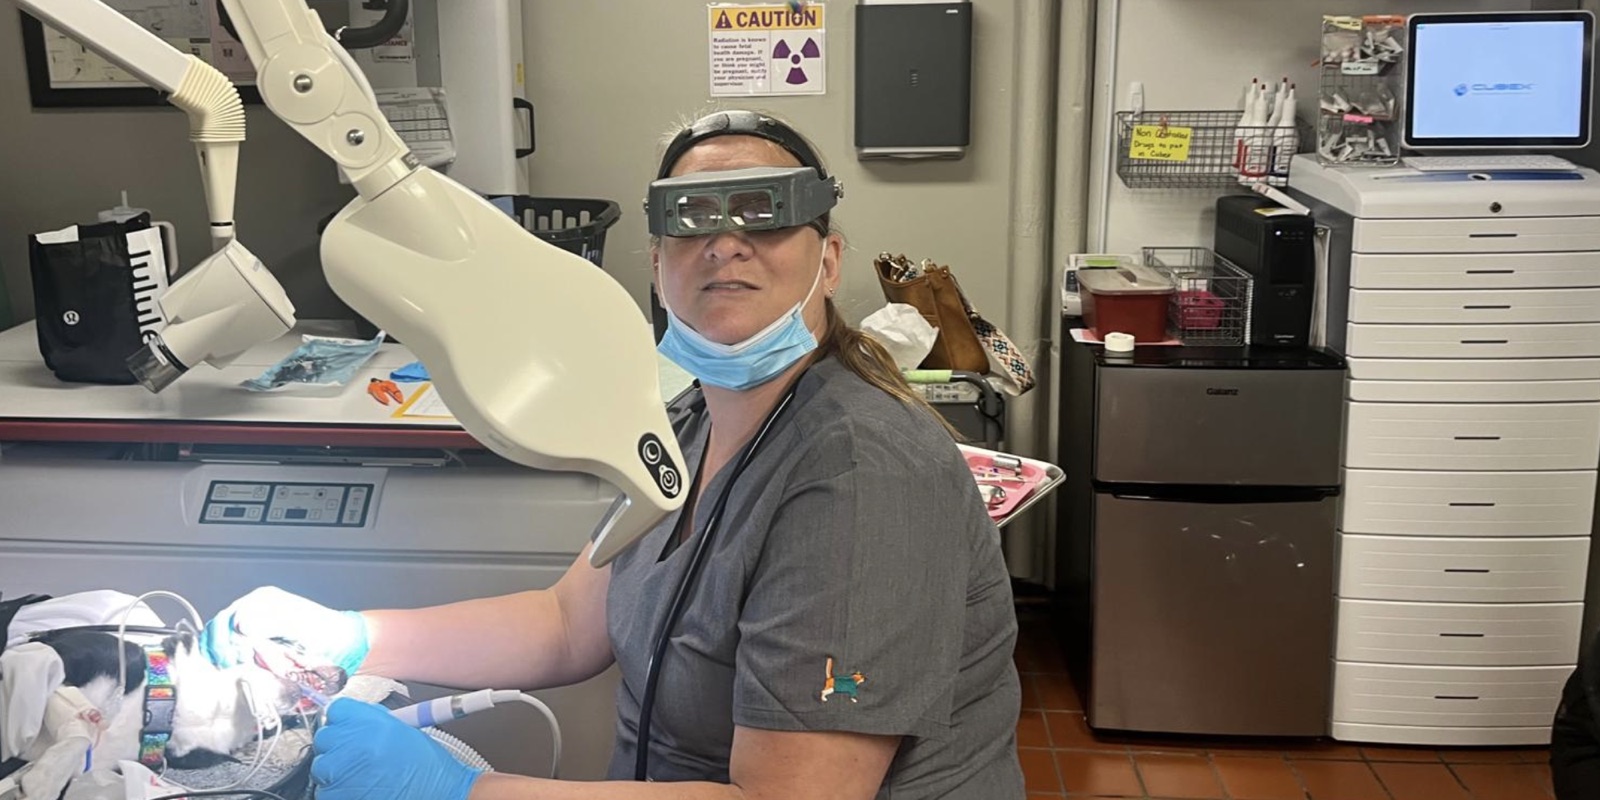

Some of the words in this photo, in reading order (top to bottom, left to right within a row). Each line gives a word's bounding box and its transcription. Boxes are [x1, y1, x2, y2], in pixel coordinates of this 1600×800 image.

[736, 10, 816, 27] CAUTION
[1471, 83, 1537, 91] CUBEX
[1136, 128, 1151, 138] Non
[1134, 140, 1154, 150] Drugs
[1206, 387, 1239, 395] Galanz
